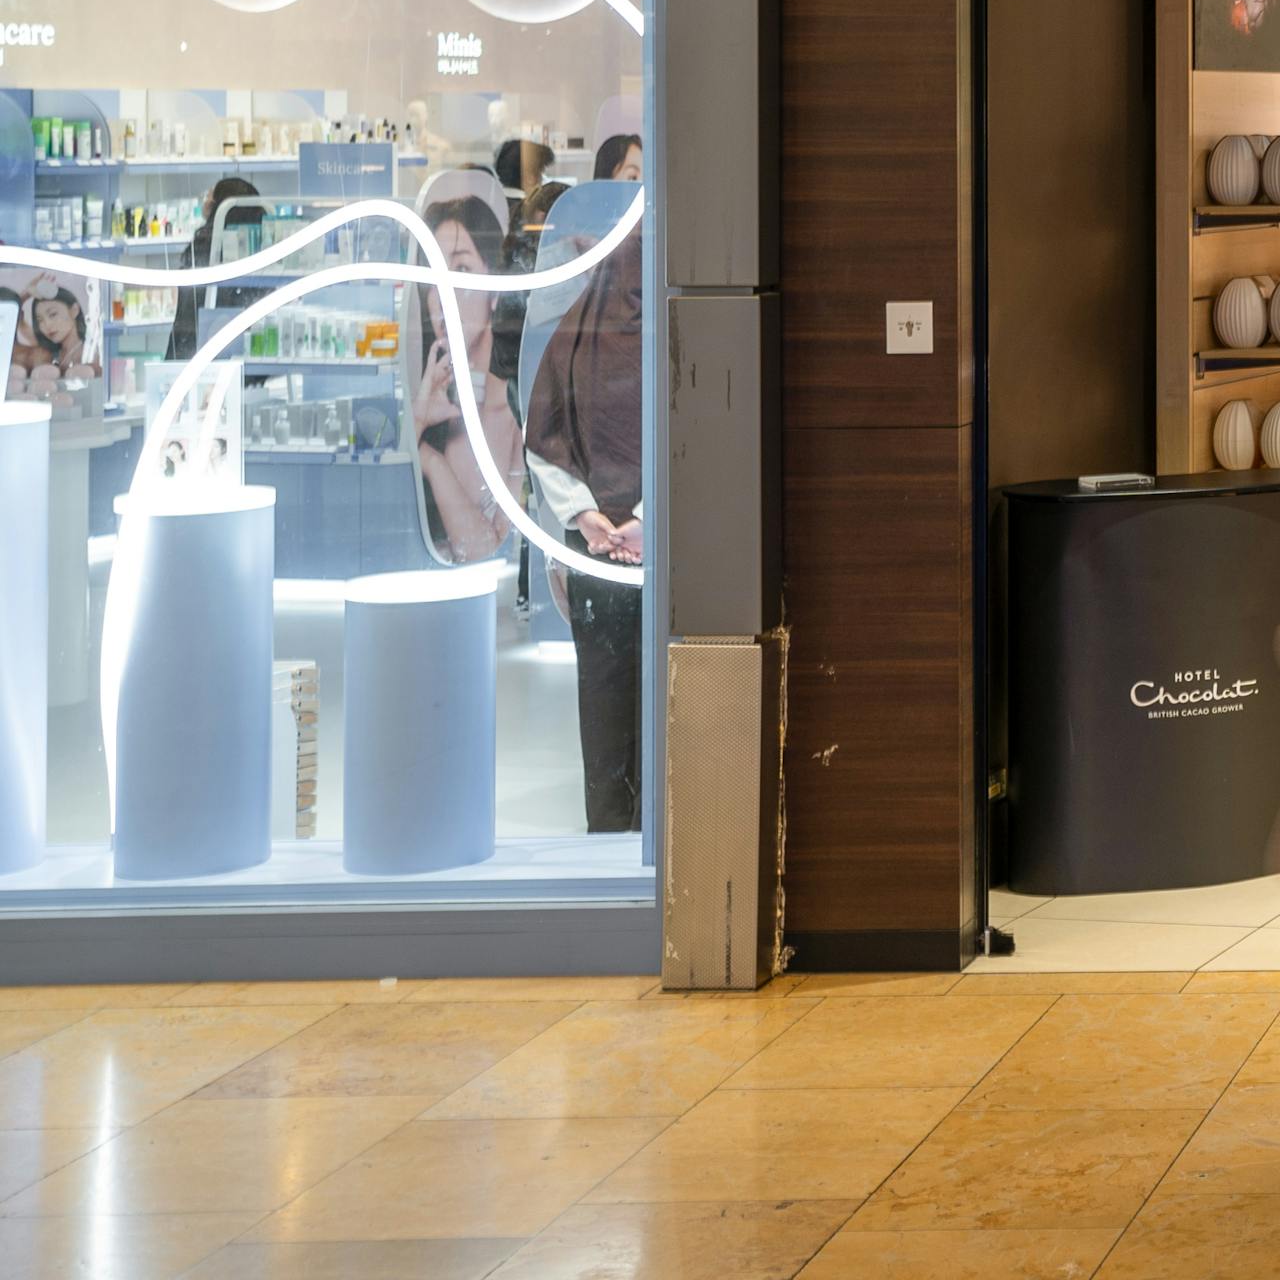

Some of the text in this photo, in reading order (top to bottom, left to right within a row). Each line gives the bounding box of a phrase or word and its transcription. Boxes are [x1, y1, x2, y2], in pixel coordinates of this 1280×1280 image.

[0, 23, 55, 46] care
[438, 32, 482, 58] Minis
[1174, 669, 1220, 682] HOTEL
[1148, 703, 1244, 719] BRITISH CACAO GROWER
